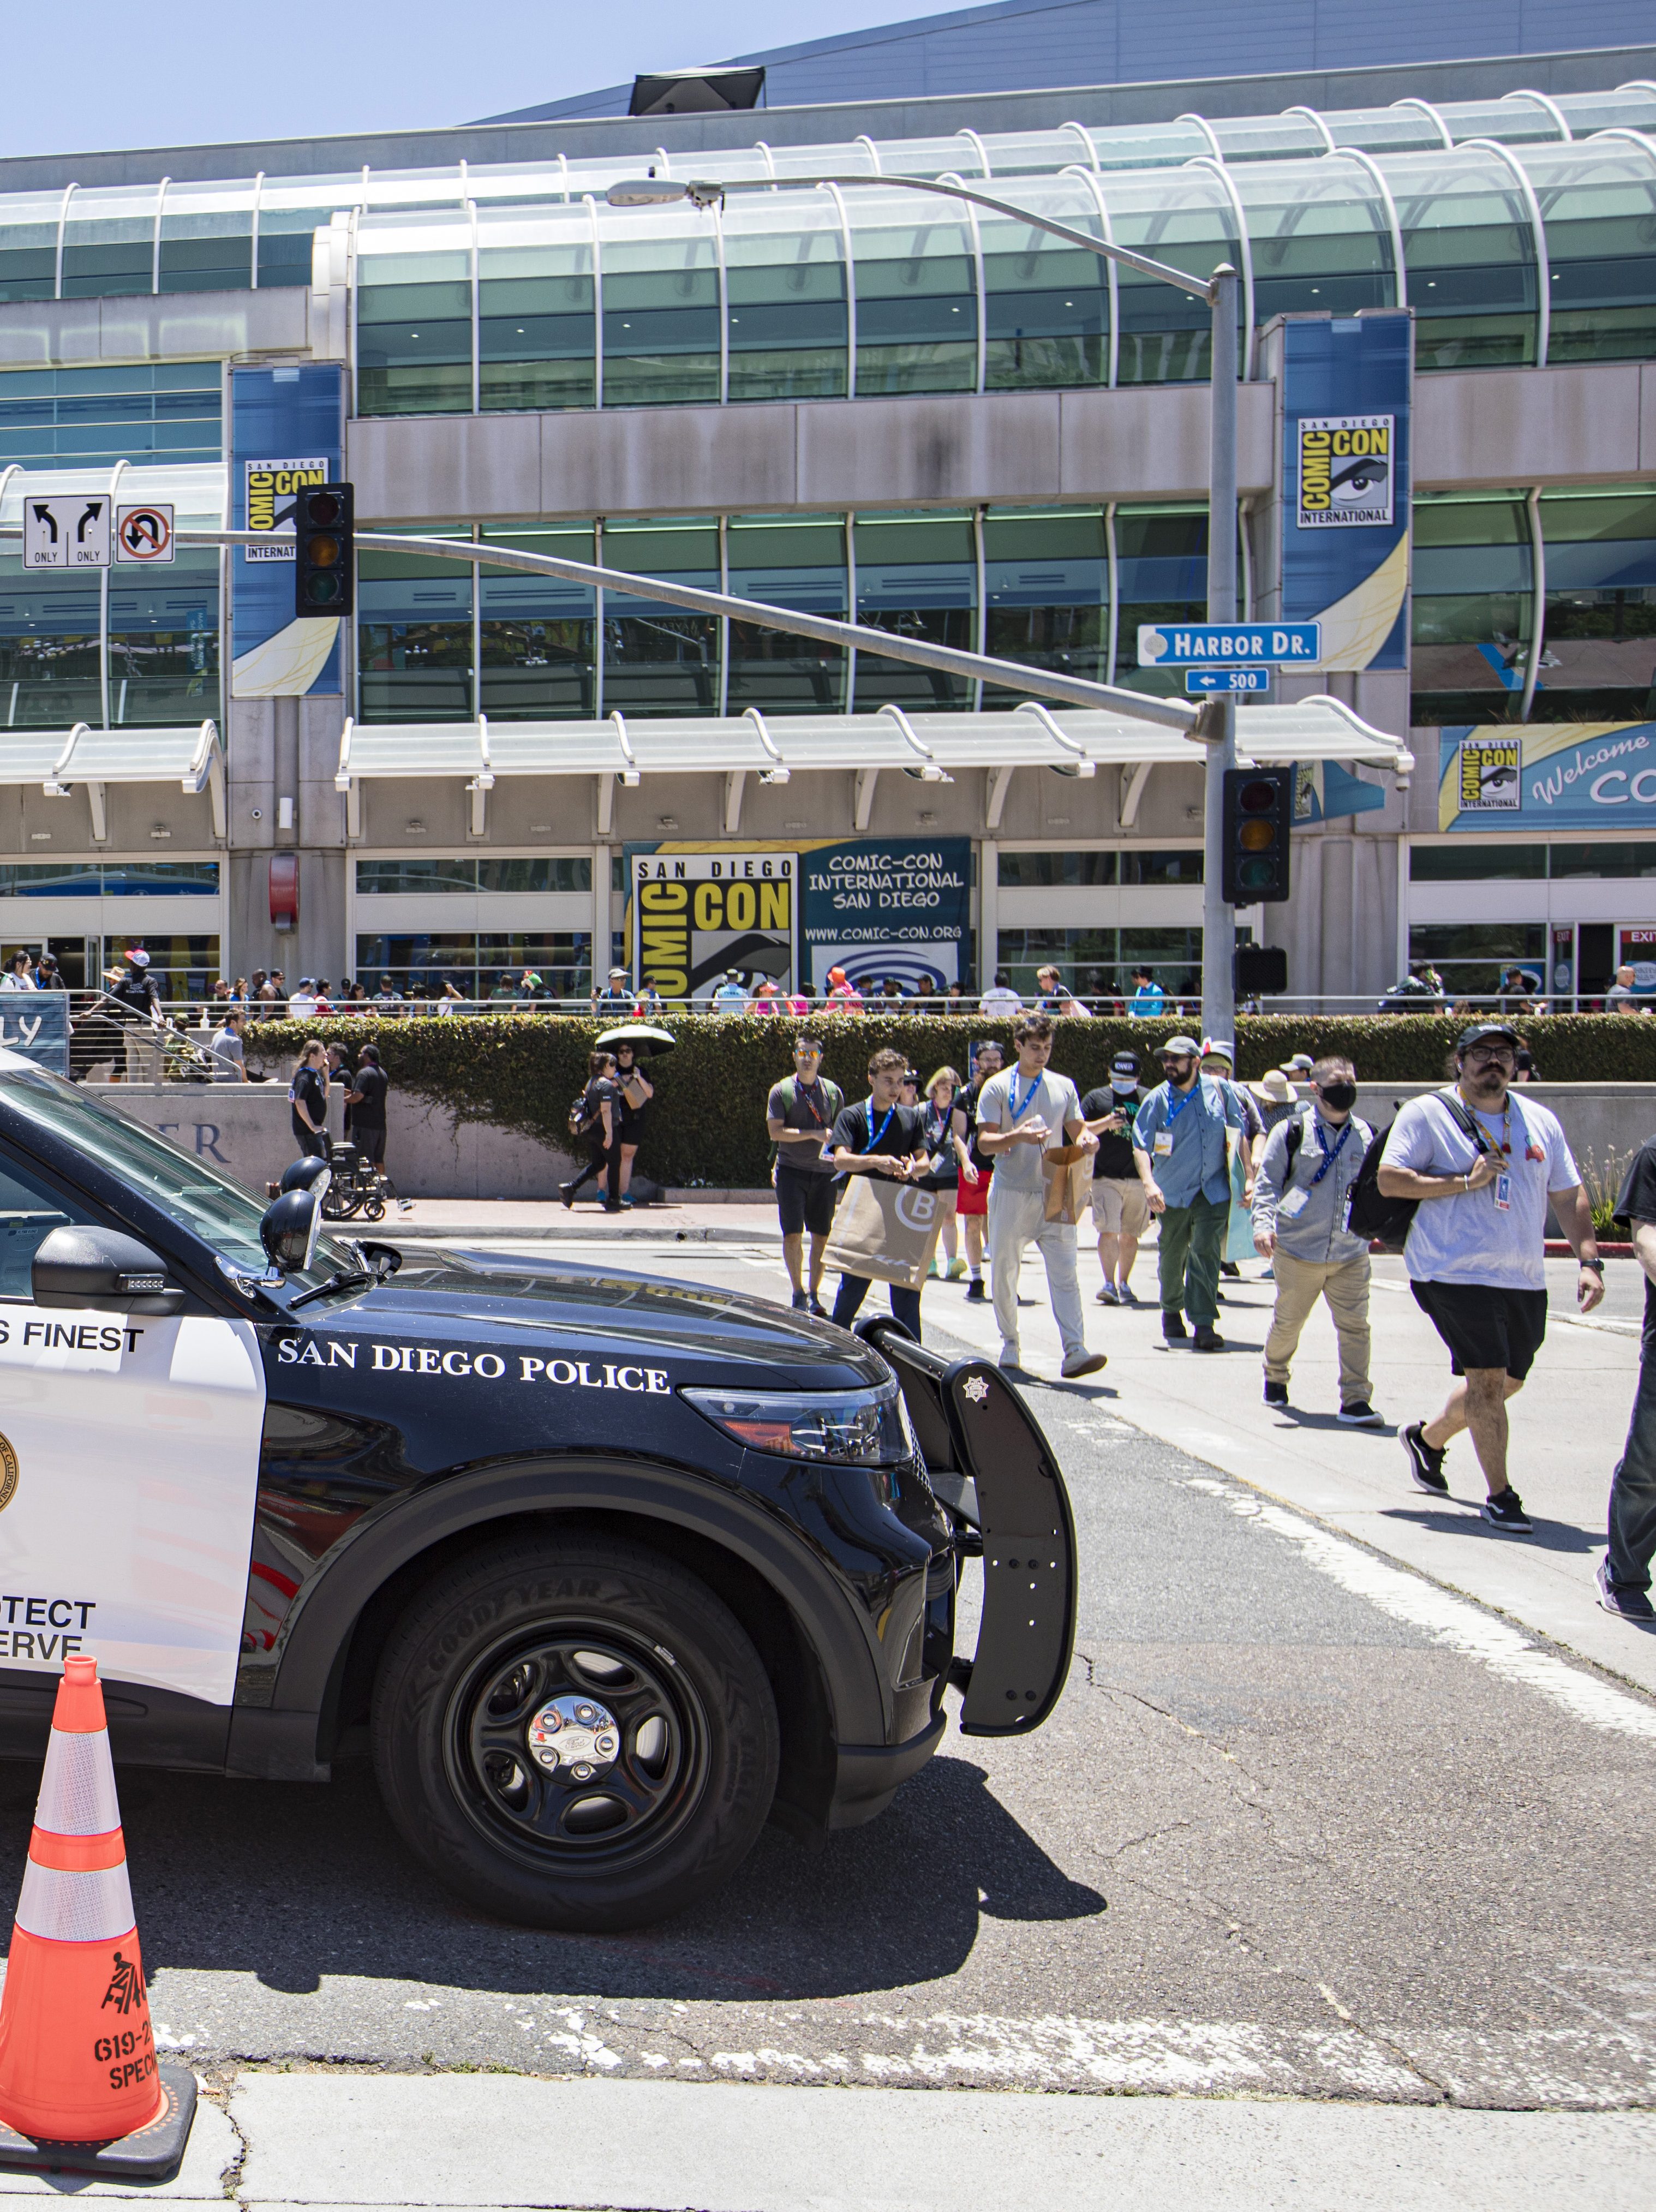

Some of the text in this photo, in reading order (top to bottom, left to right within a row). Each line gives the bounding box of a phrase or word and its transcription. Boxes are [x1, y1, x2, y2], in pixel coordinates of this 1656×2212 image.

[1301, 418, 1389, 429] SAN DIEGO
[1332, 428, 1388, 456] CON
[283, 461, 324, 469] DIEGO
[1302, 431, 1331, 510] COMIC
[276, 470, 324, 495] CON
[249, 473, 274, 530] OMIC
[1300, 509, 1388, 523] INTERNATIONAL
[35, 552, 58, 563] ONLY
[77, 551, 100, 561] ONLY
[1175, 631, 1310, 656] HARBOR DR.
[1229, 673, 1257, 689] 500
[1481, 749, 1517, 767] CON
[1462, 749, 1480, 800] COMIC
[1533, 736, 1650, 805] Welcome
[1590, 769, 1656, 804] CO
[1461, 799, 1517, 808] INTERNATIONAL
[638, 860, 791, 878] SAN DIEGO
[829, 853, 942, 871] COMIC-CON
[809, 872, 965, 891] INTERNATIONAL
[694, 882, 789, 931] CON
[833, 892, 940, 910] SAN DIEGO
[805, 926, 962, 941] WWW.COMIC-CON.ORG
[1557, 930, 1570, 941] EXIT
[23, 1322, 145, 1353] FINEST
[278, 1338, 671, 1395] SAN DIEGO POLICE
[0, 1595, 96, 1630] TECT
[428, 1577, 602, 1671] GOODYEAR
[94, 2020, 153, 2062] 619-2
